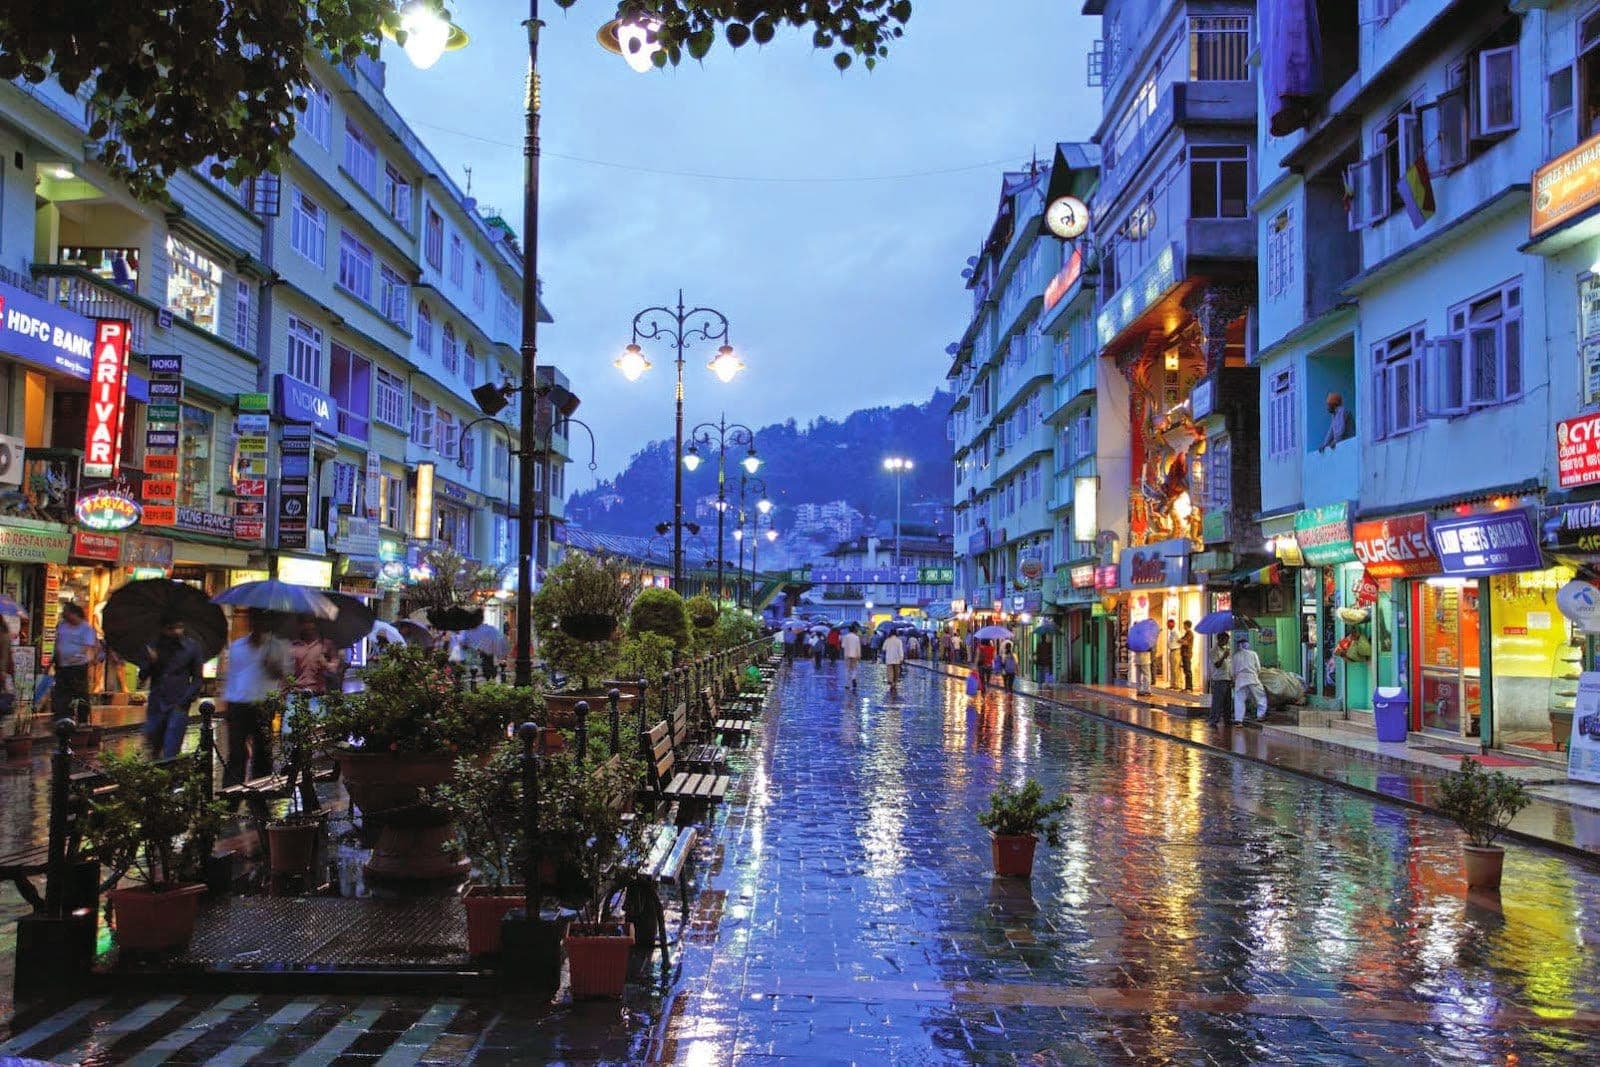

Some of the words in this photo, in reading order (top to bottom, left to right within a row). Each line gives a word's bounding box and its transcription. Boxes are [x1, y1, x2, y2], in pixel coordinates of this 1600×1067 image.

[7, 308, 51, 342] HDFC
[53, 326, 93, 359] BANK
[151, 359, 179, 369] NOKIA
[89, 323, 121, 462] PARIVAR
[291, 387, 330, 420] NOKIA
[147, 485, 173, 496] SOLD
[287, 498, 301, 513] hp
[203, 512, 232, 530] FRANCE
[12, 533, 69, 550] RESTAURANT
[1486, 520, 1530, 549] BHANDAR
[1355, 530, 1430, 563] DURGA'S
